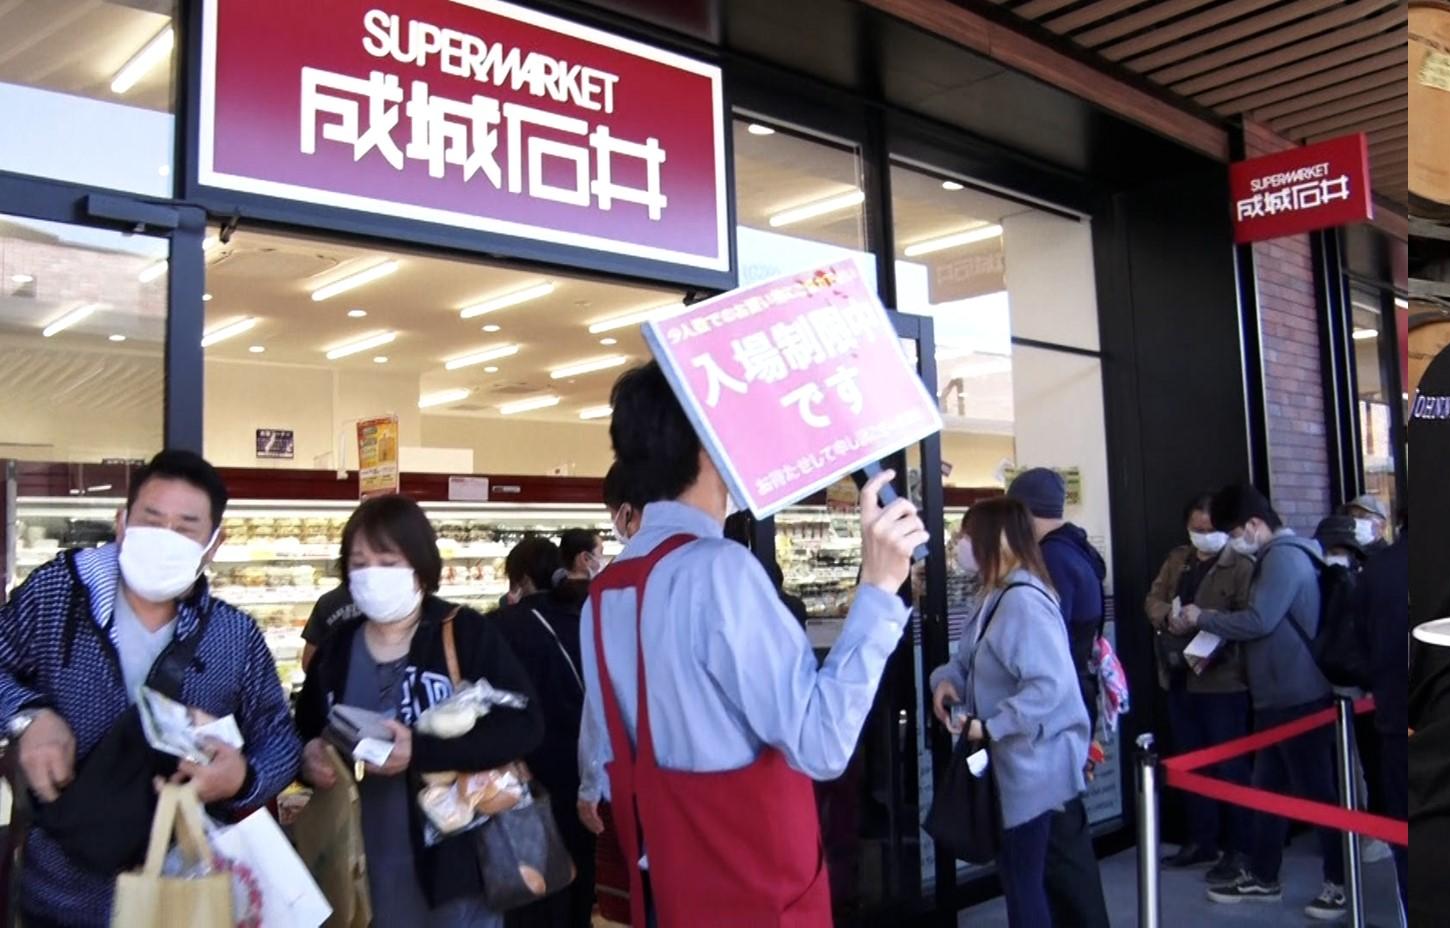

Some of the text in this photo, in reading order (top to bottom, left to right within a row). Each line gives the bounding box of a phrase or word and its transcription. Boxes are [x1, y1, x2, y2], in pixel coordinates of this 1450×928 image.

[362, 9, 620, 114] SUPERMARKET
[300, 66, 667, 221] 成城石井
[1236, 174, 1350, 222] 成城石井
[1250, 162, 1330, 192] SUPERMARKET
[779, 364, 864, 428] です
